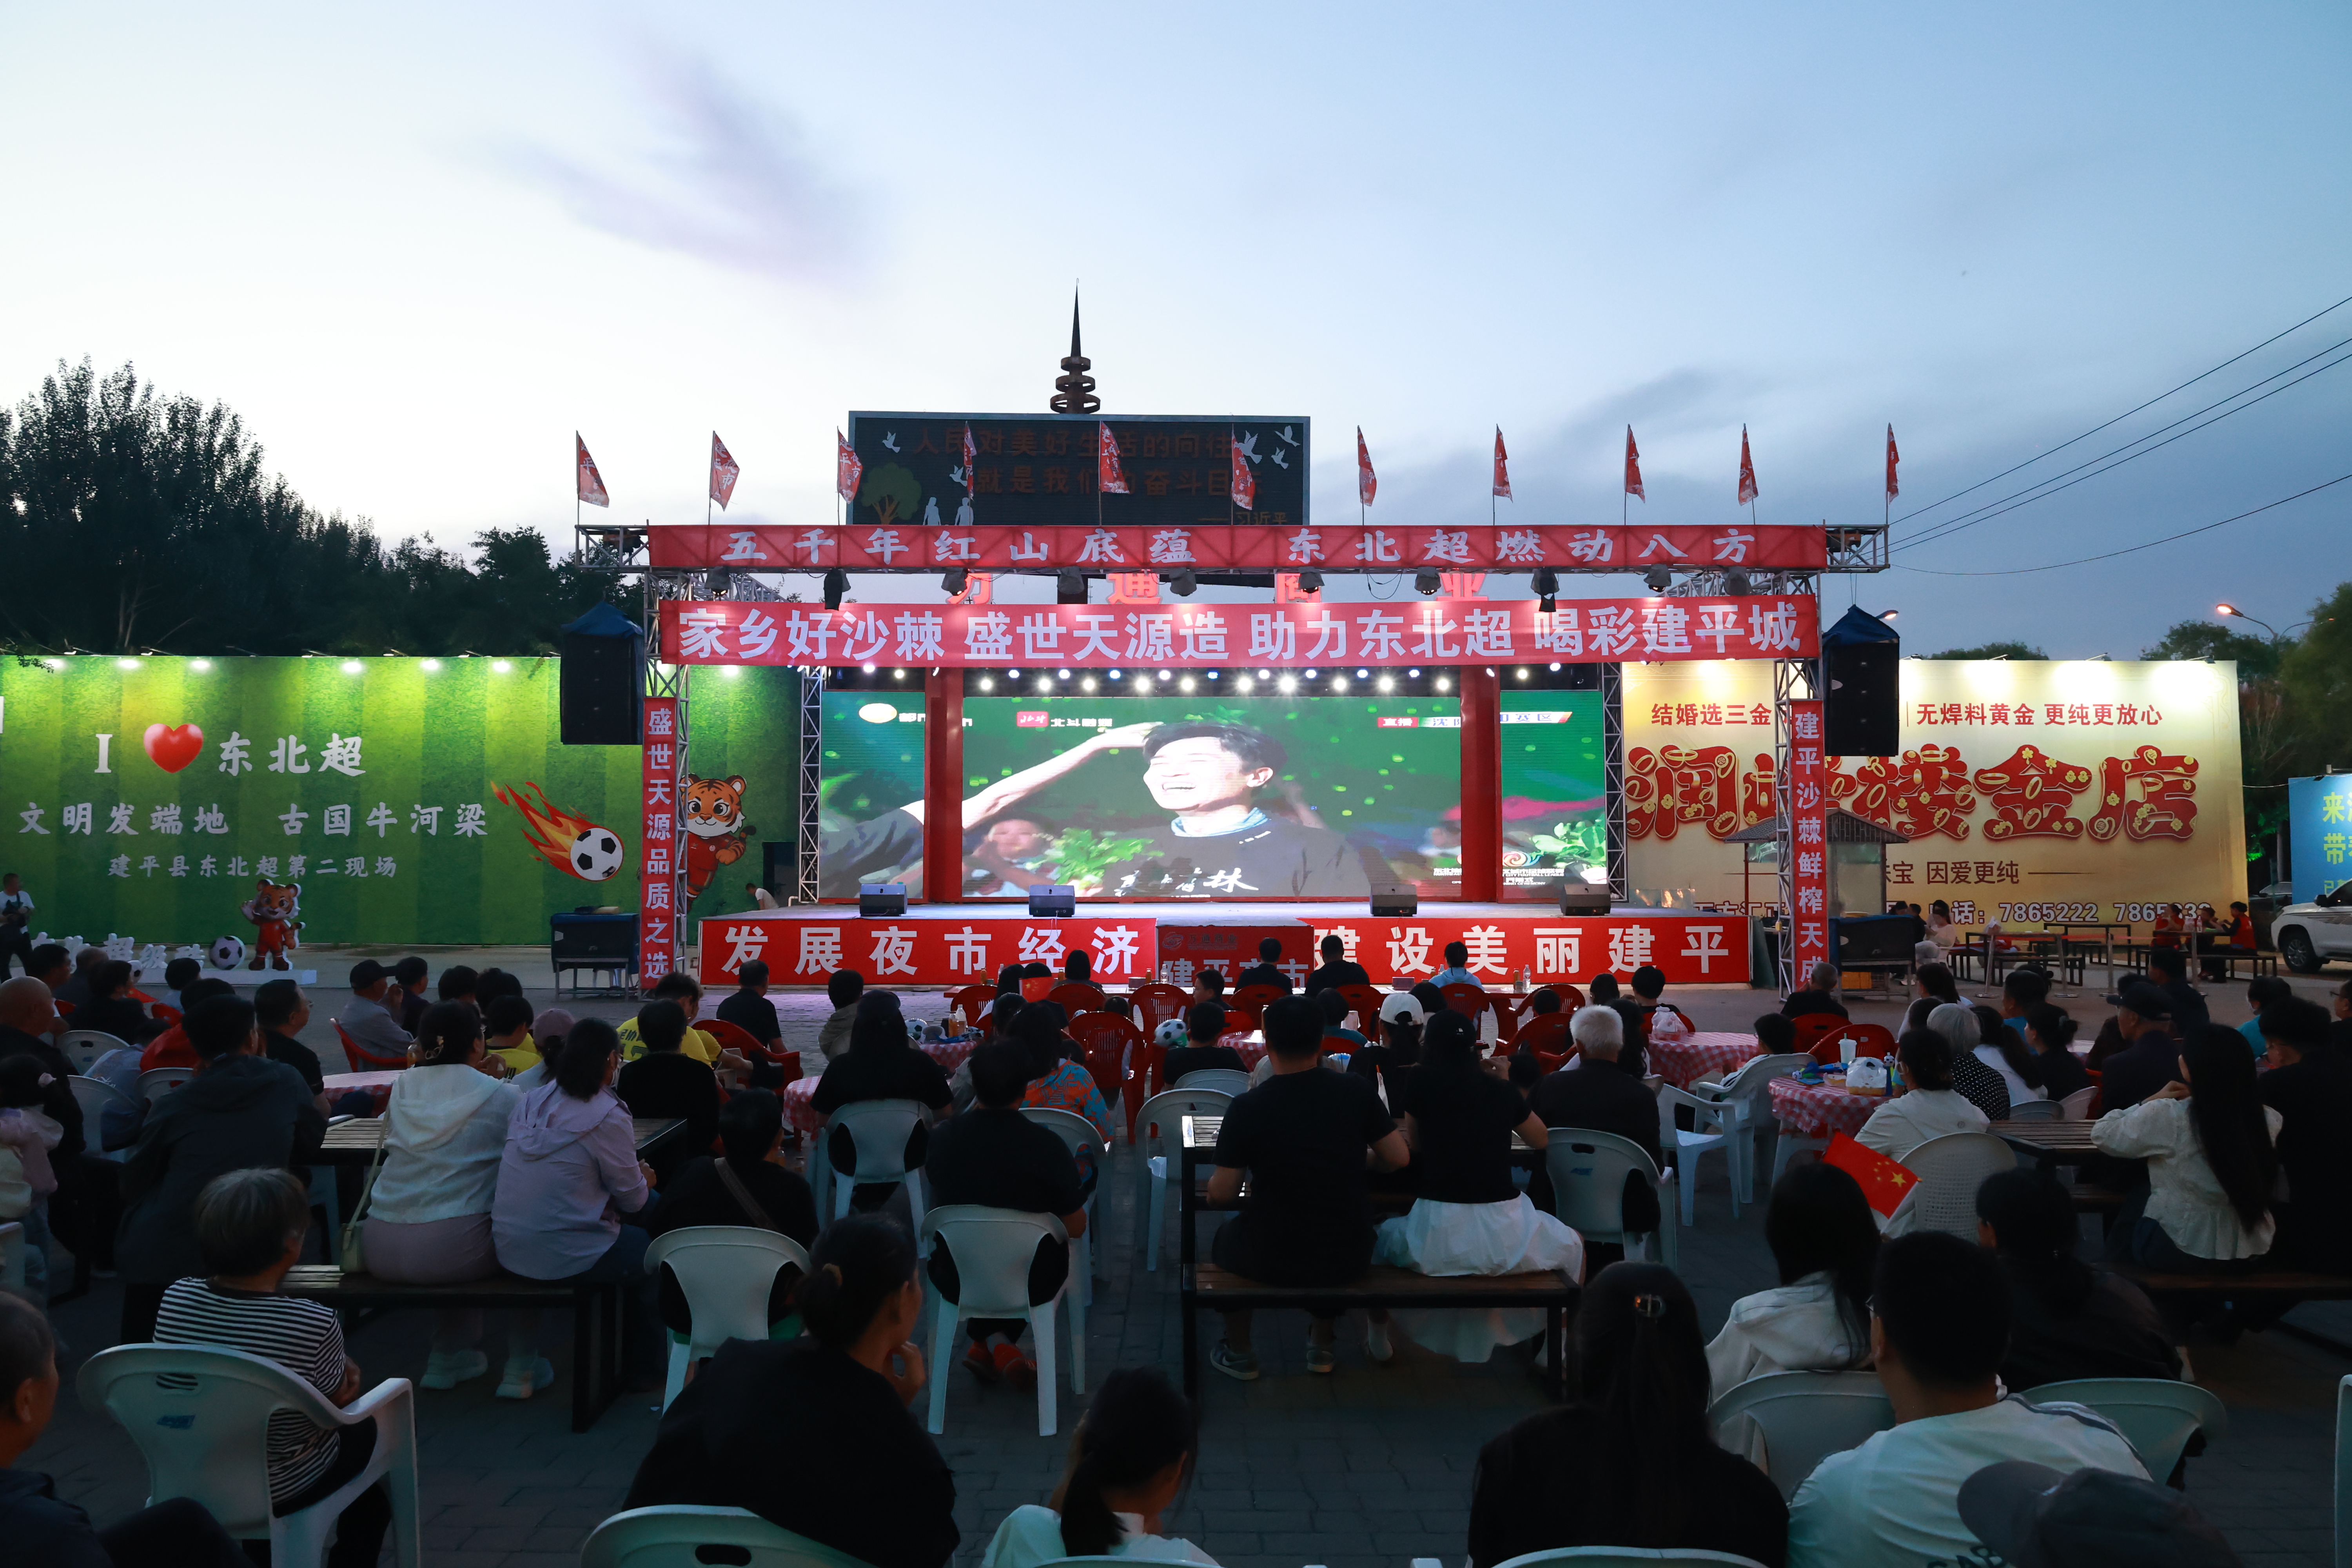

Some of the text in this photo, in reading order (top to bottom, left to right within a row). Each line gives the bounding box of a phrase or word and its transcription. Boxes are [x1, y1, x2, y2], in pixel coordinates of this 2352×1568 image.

[720, 528, 1755, 564] 五千年红山底蕴 东北超燃动八方
[679, 602, 1802, 662] 家乡好沙棘 盛世天源造 助力东北超 喝彩建平城
[1383, 718, 1413, 726] 直播
[1916, 702, 2036, 726] 无焊料黄金
[2043, 702, 2163, 726] 更纯更放心
[94, 731, 366, 777] I 东北超
[18, 801, 488, 838] 文明发端地 古国牛河梁
[644, 708, 673, 979] 盛世天源品质之选
[1795, 712, 1824, 983] 建平沙棘鲜榨天成
[107, 853, 397, 880] 建平县东北超第二现场
[1926, 861, 2020, 884] 因爱更纯
[1998, 902, 2099, 923] 7865222
[721, 925, 1139, 975] 发展夜市经济
